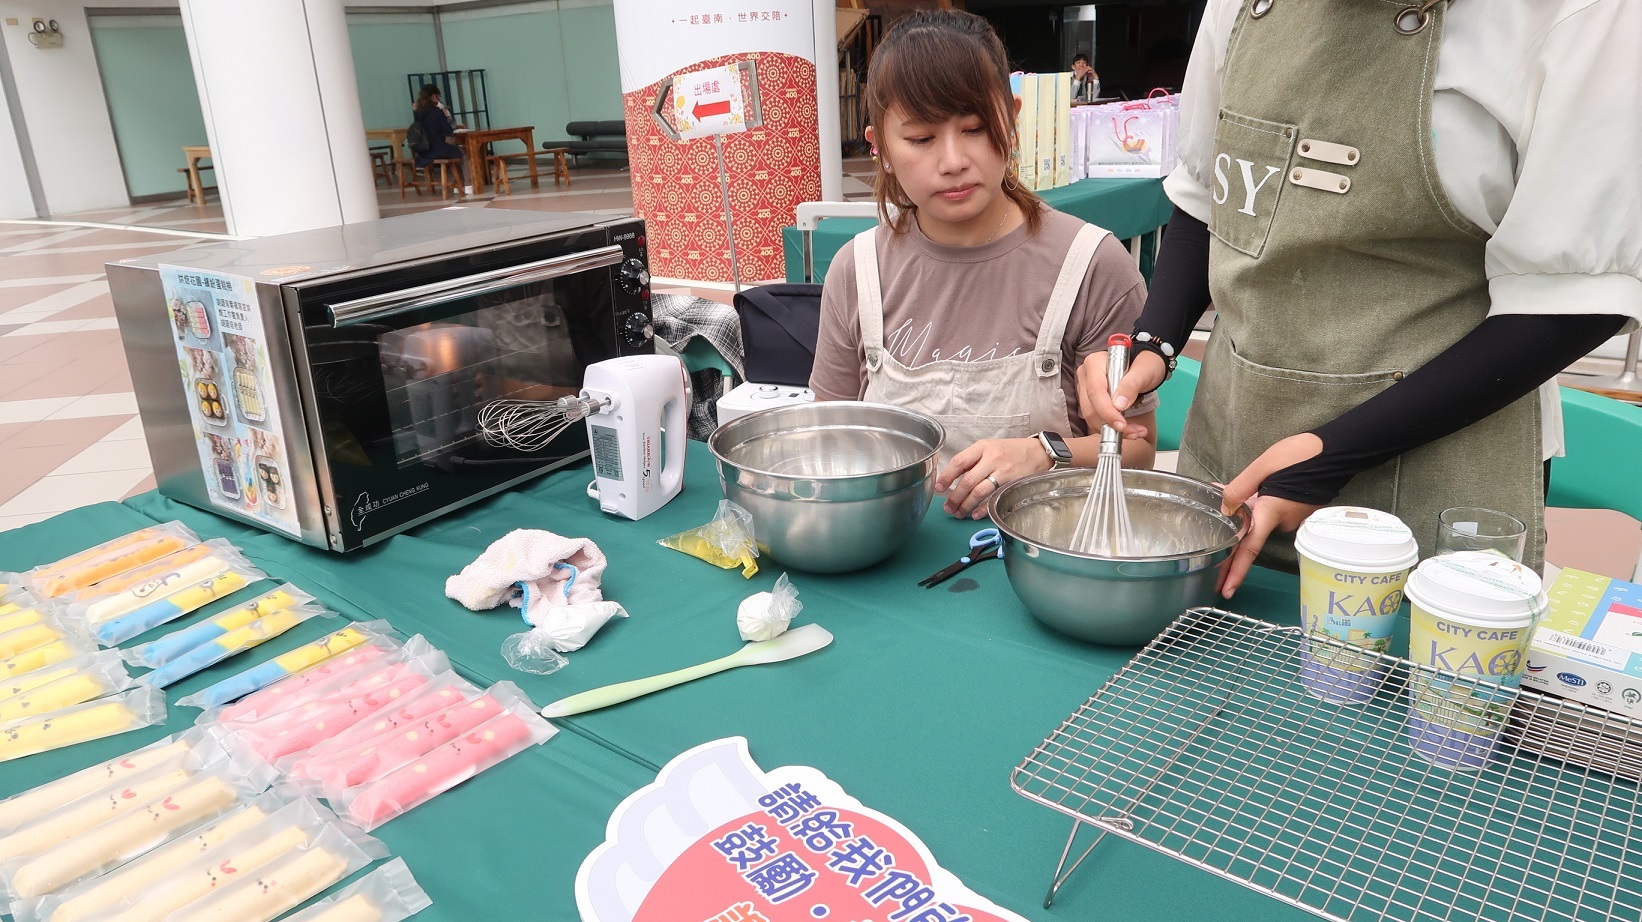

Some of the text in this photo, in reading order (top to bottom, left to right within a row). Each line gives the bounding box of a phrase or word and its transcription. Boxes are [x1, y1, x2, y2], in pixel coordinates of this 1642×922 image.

[693, 81, 720, 96] 出場處
[1212, 153, 1280, 217] SY
[643, 469, 651, 478] 5
[382, 494, 399, 504] CYUAN
[399, 487, 416, 498] CHENG
[1334, 572, 1402, 585] CITY CAFE
[1436, 621, 1518, 641] CITY CAFE
